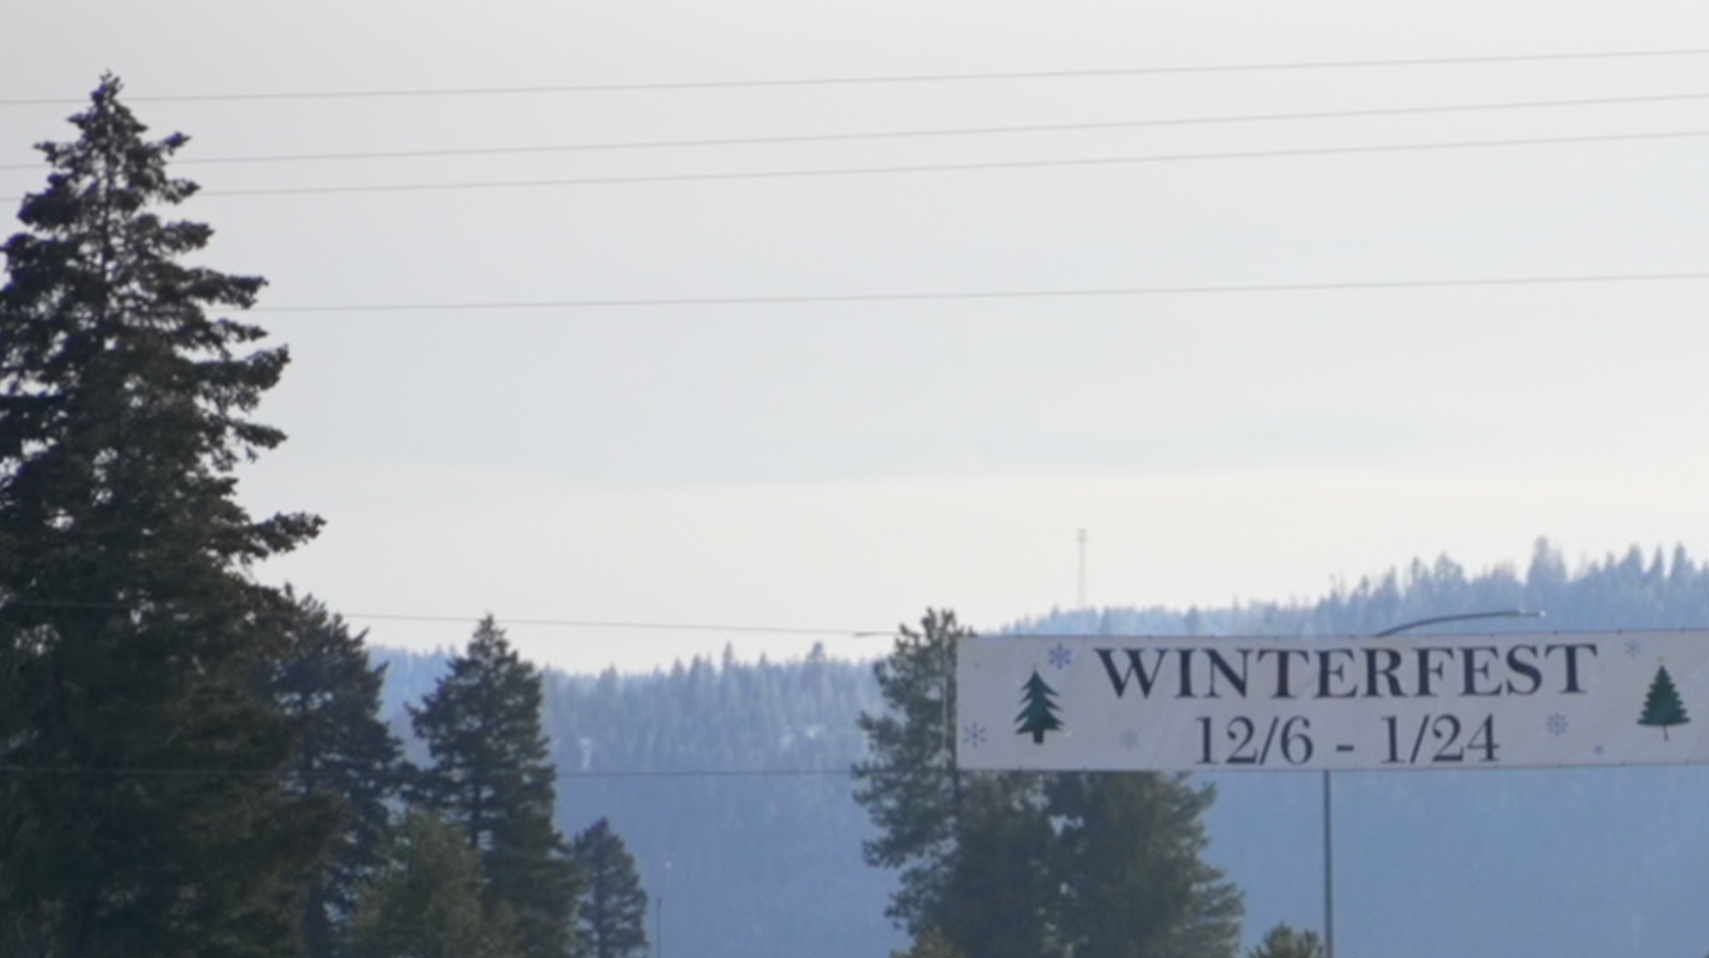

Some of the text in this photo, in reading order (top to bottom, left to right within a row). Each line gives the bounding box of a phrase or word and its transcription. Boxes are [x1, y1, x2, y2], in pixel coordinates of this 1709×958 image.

[1094, 643, 1598, 700] WINTERFEST
[1196, 714, 1314, 765] 12/6
[1382, 713, 1501, 763] 1/24
